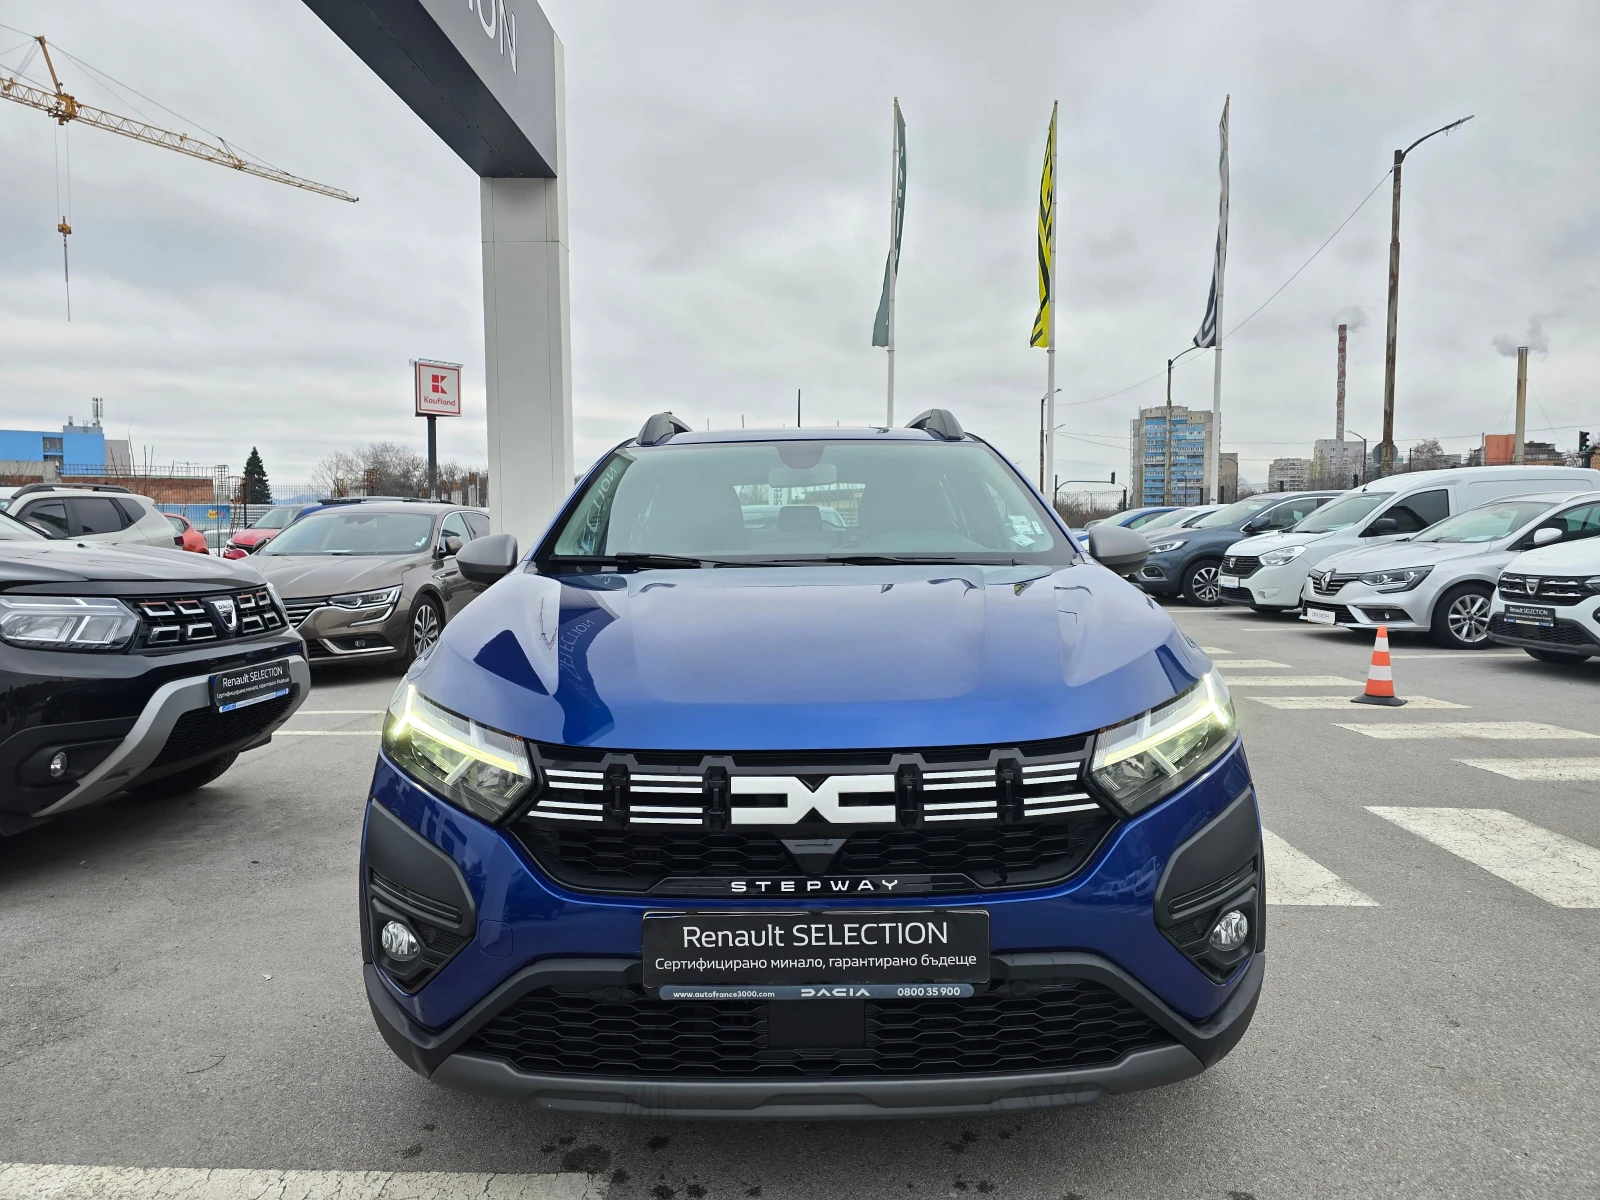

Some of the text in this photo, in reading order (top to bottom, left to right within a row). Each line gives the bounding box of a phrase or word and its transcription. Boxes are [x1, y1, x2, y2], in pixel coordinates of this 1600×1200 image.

[468, 0, 518, 74] ON
[423, 396, 456, 406] Kaufland
[222, 674, 250, 687] Renault
[250, 666, 283, 682] SELECTION
[731, 879, 898, 892] STEPWAY
[682, 921, 948, 948] Renault SELECTION
[655, 953, 977, 972] Сертифицирано минало, гарантирано бъдеще
[673, 987, 961, 998] www.autofrance3000.com DACIA 0800 35 900
